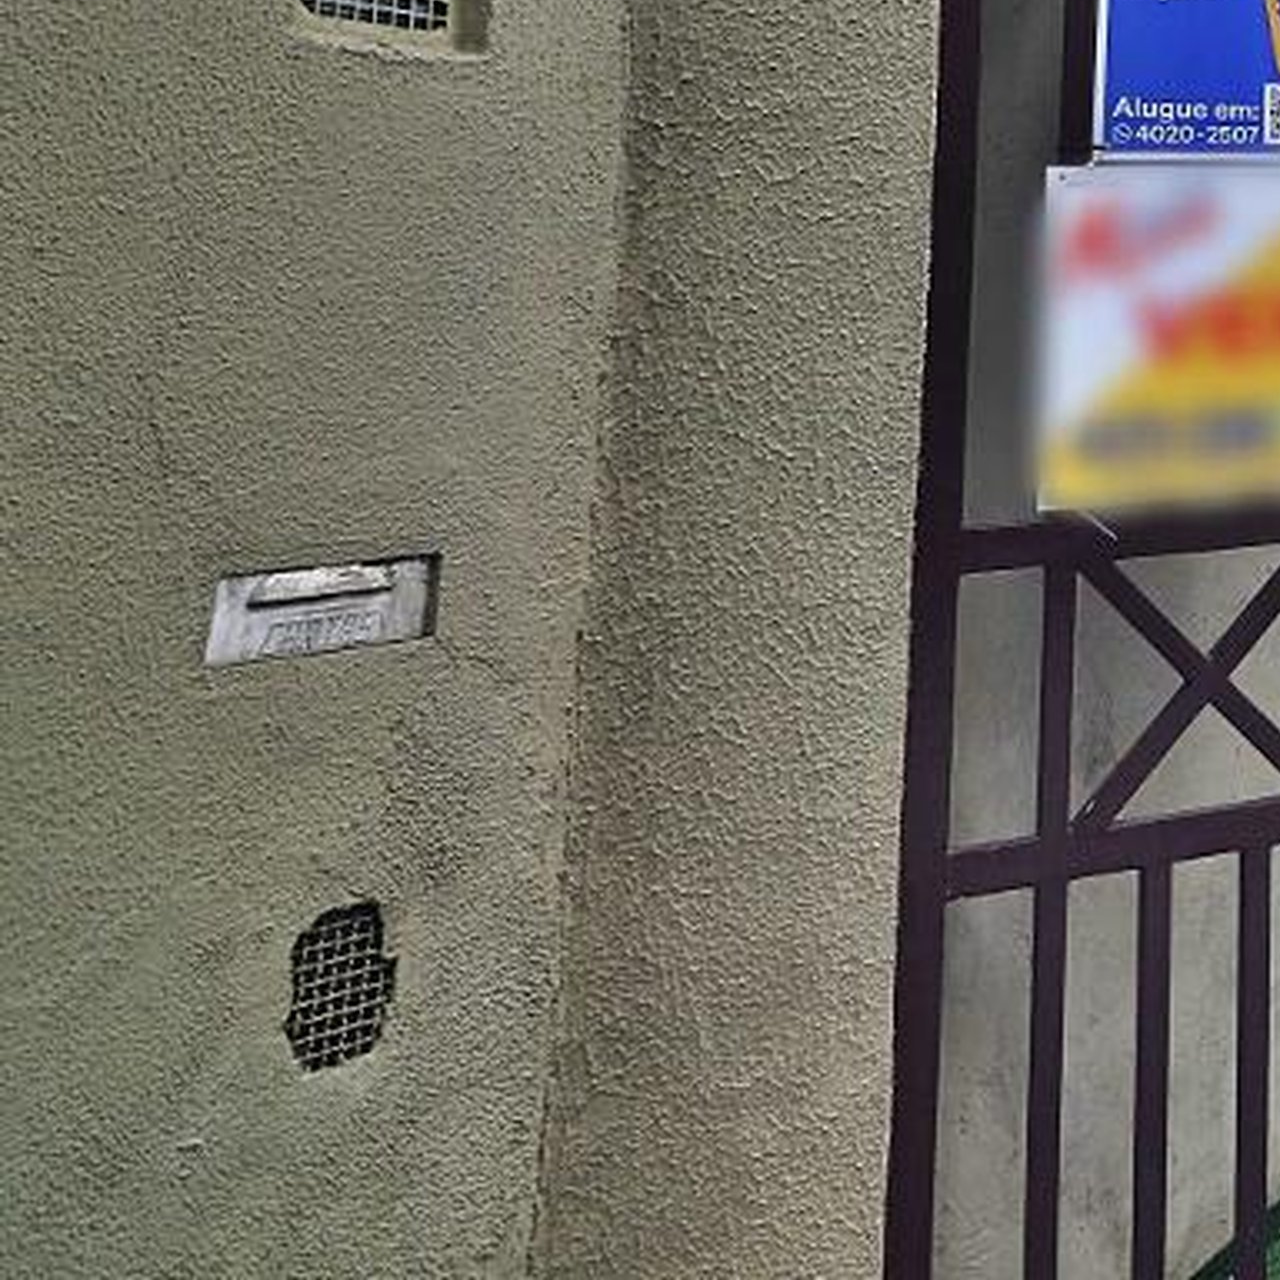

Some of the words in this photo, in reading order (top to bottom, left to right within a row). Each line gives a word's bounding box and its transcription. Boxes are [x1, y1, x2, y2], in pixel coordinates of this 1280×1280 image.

[1112, 96, 1208, 123] Alugue
[1214, 103, 1260, 121] em:
[1135, 124, 1261, 145] 4020-2507
